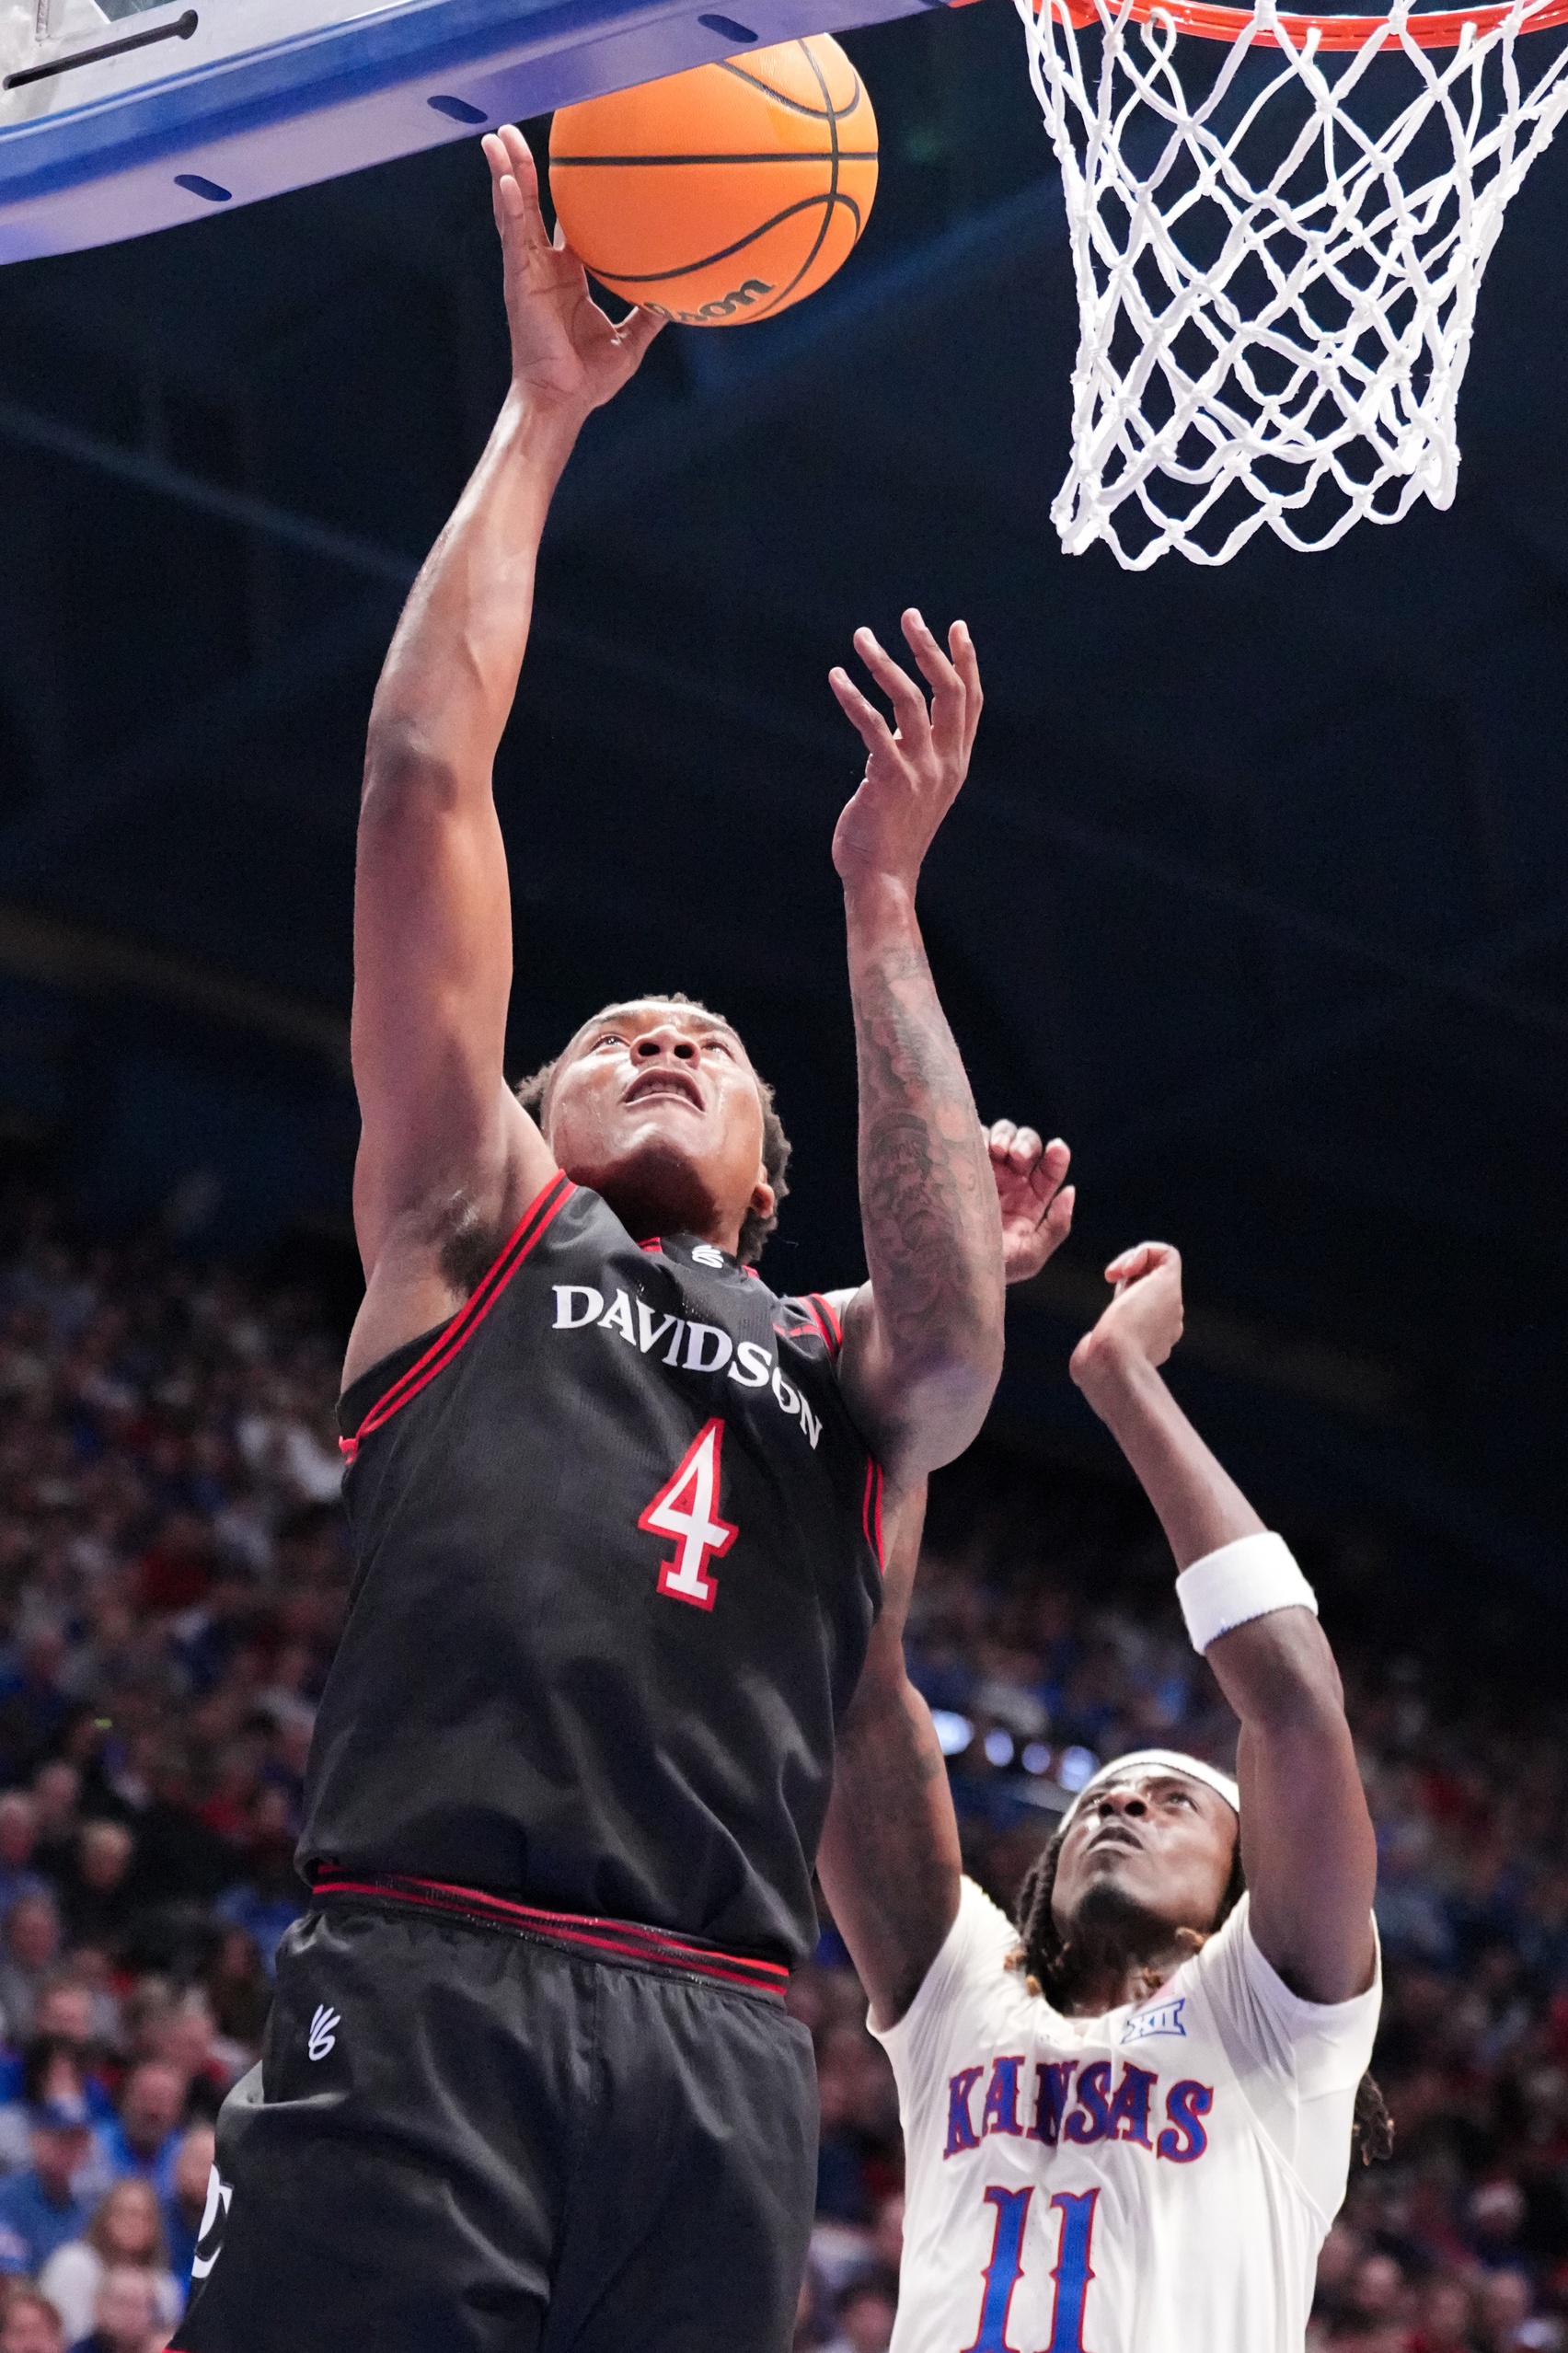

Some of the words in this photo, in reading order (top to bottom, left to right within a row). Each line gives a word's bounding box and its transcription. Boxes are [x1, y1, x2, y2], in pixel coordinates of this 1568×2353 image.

[552, 1286, 823, 1450] DAVIDSON
[638, 1416, 739, 1612] 4
[943, 2055, 1214, 2163] KANSAS
[960, 2185, 1101, 2353] 11
